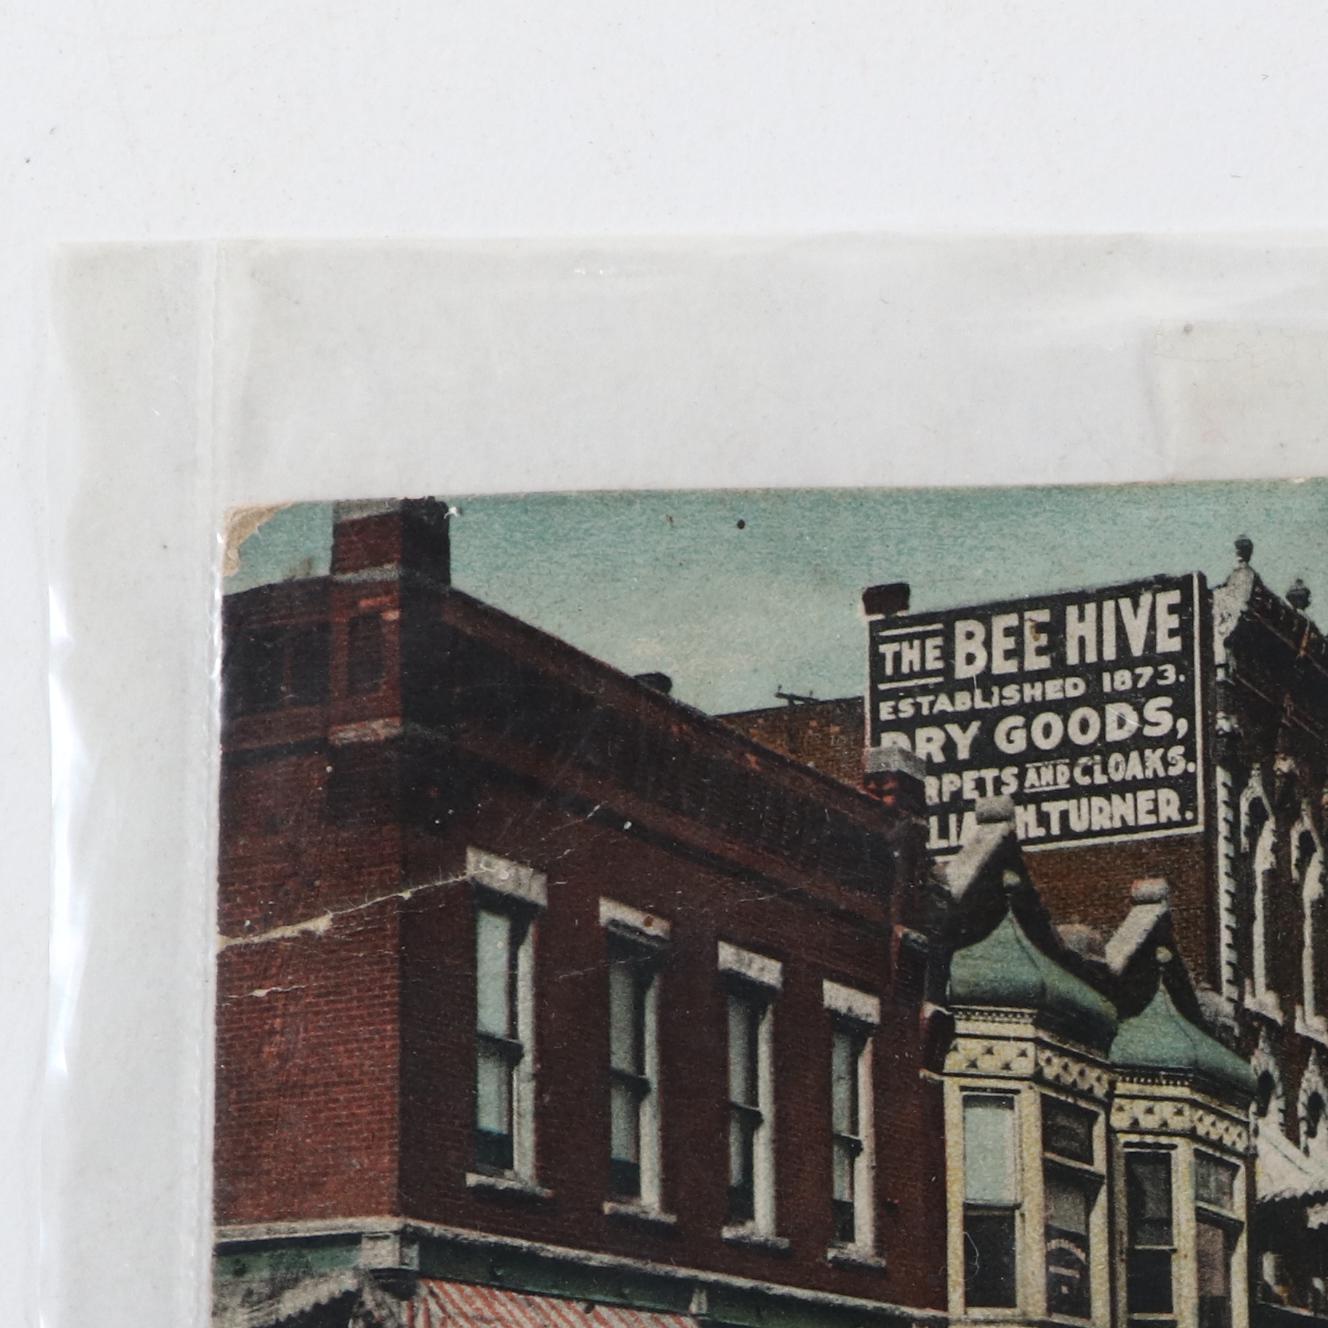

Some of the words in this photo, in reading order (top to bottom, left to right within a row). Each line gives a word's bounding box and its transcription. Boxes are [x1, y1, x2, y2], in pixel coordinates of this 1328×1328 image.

[878, 636, 945, 677] THE
[953, 608, 1051, 680] BEE
[1065, 589, 1182, 666] HIVE
[878, 677, 1087, 722] ESTABLISHED
[1102, 663, 1186, 693] 1873.
[993, 696, 1189, 755] GOODS,
[1024, 764, 1071, 788] AND
[1072, 745, 1197, 786] CLOAKS.
[1041, 787, 1194, 835] TURNER.
